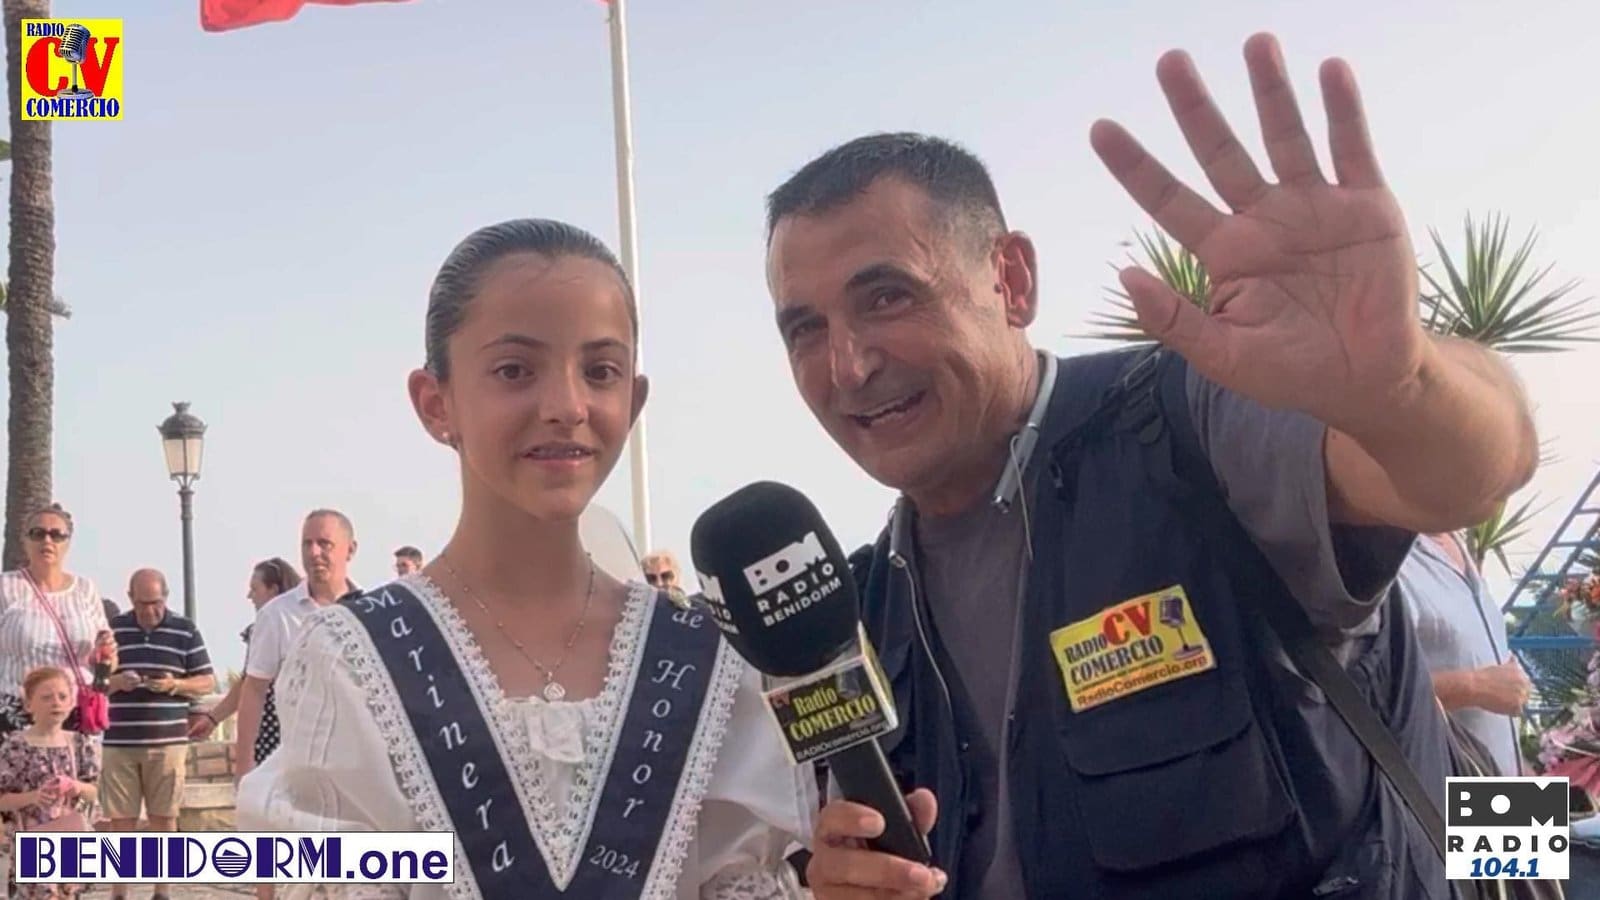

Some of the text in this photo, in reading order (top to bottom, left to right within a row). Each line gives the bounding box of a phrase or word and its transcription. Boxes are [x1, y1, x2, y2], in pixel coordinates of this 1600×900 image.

[743, 531, 827, 596] BOM
[757, 562, 834, 613] RADIO
[671, 606, 704, 628] de
[763, 577, 842, 627] BENIDORM
[1064, 601, 1152, 664] RADIO CV
[1070, 635, 1164, 686] COMERCIO
[790, 694, 876, 741] COMERCIO
[792, 687, 838, 718] Radio
[355, 589, 515, 872] Marinera
[622, 659, 696, 818] Honor
[589, 846, 640, 879] 2024
